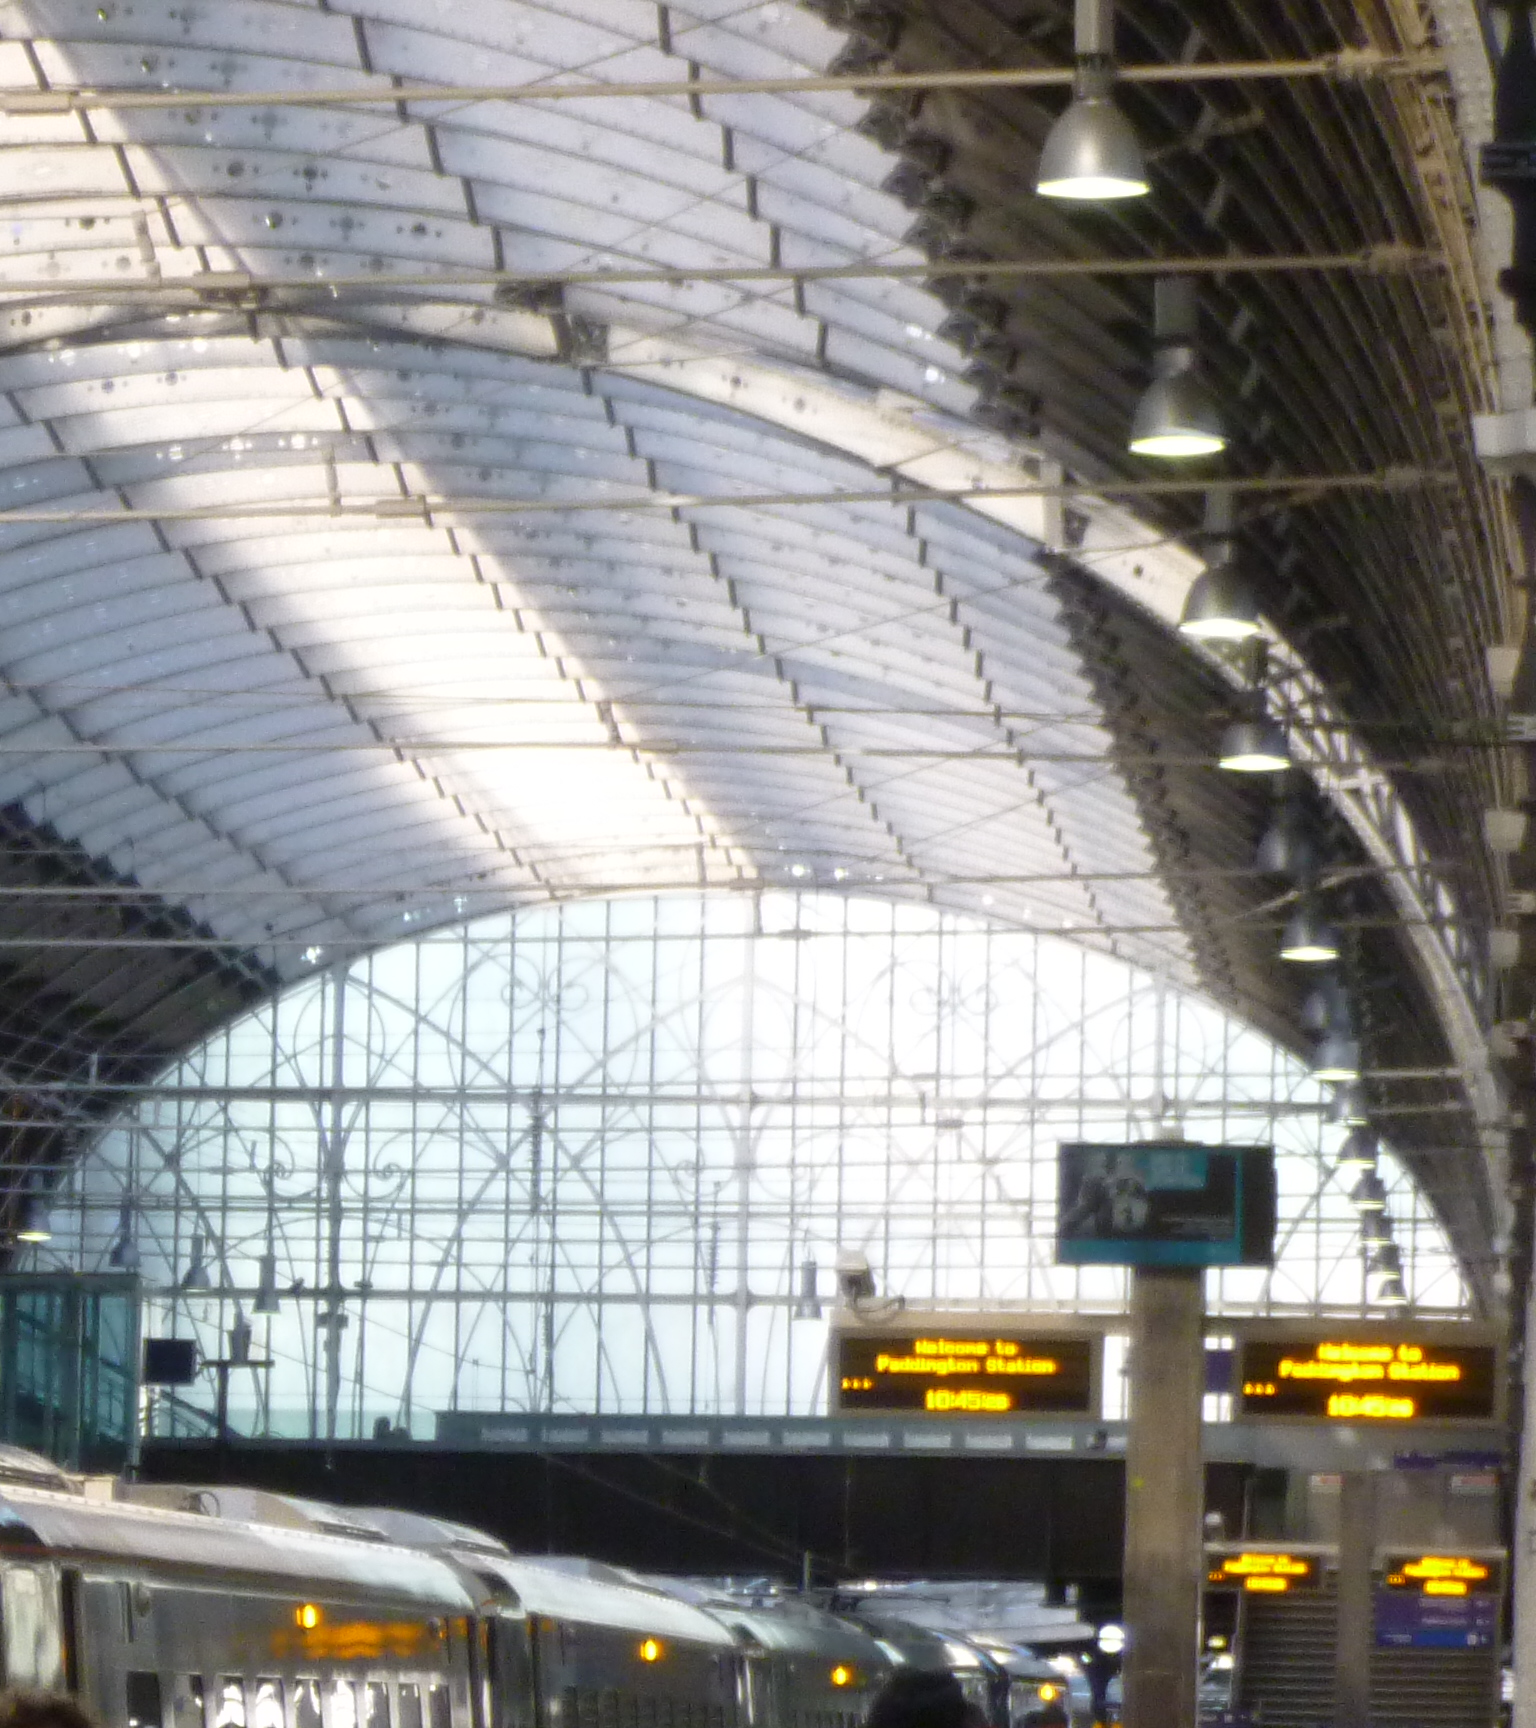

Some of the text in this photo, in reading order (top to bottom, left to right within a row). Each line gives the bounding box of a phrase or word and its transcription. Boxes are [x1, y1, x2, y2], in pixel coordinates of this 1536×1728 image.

[915, 1339, 1018, 1356] Welcome to
[1318, 1343, 1422, 1361] Welcome to
[876, 1354, 1057, 1377] Paddington Station
[1280, 1359, 1460, 1382] Paddington Station
